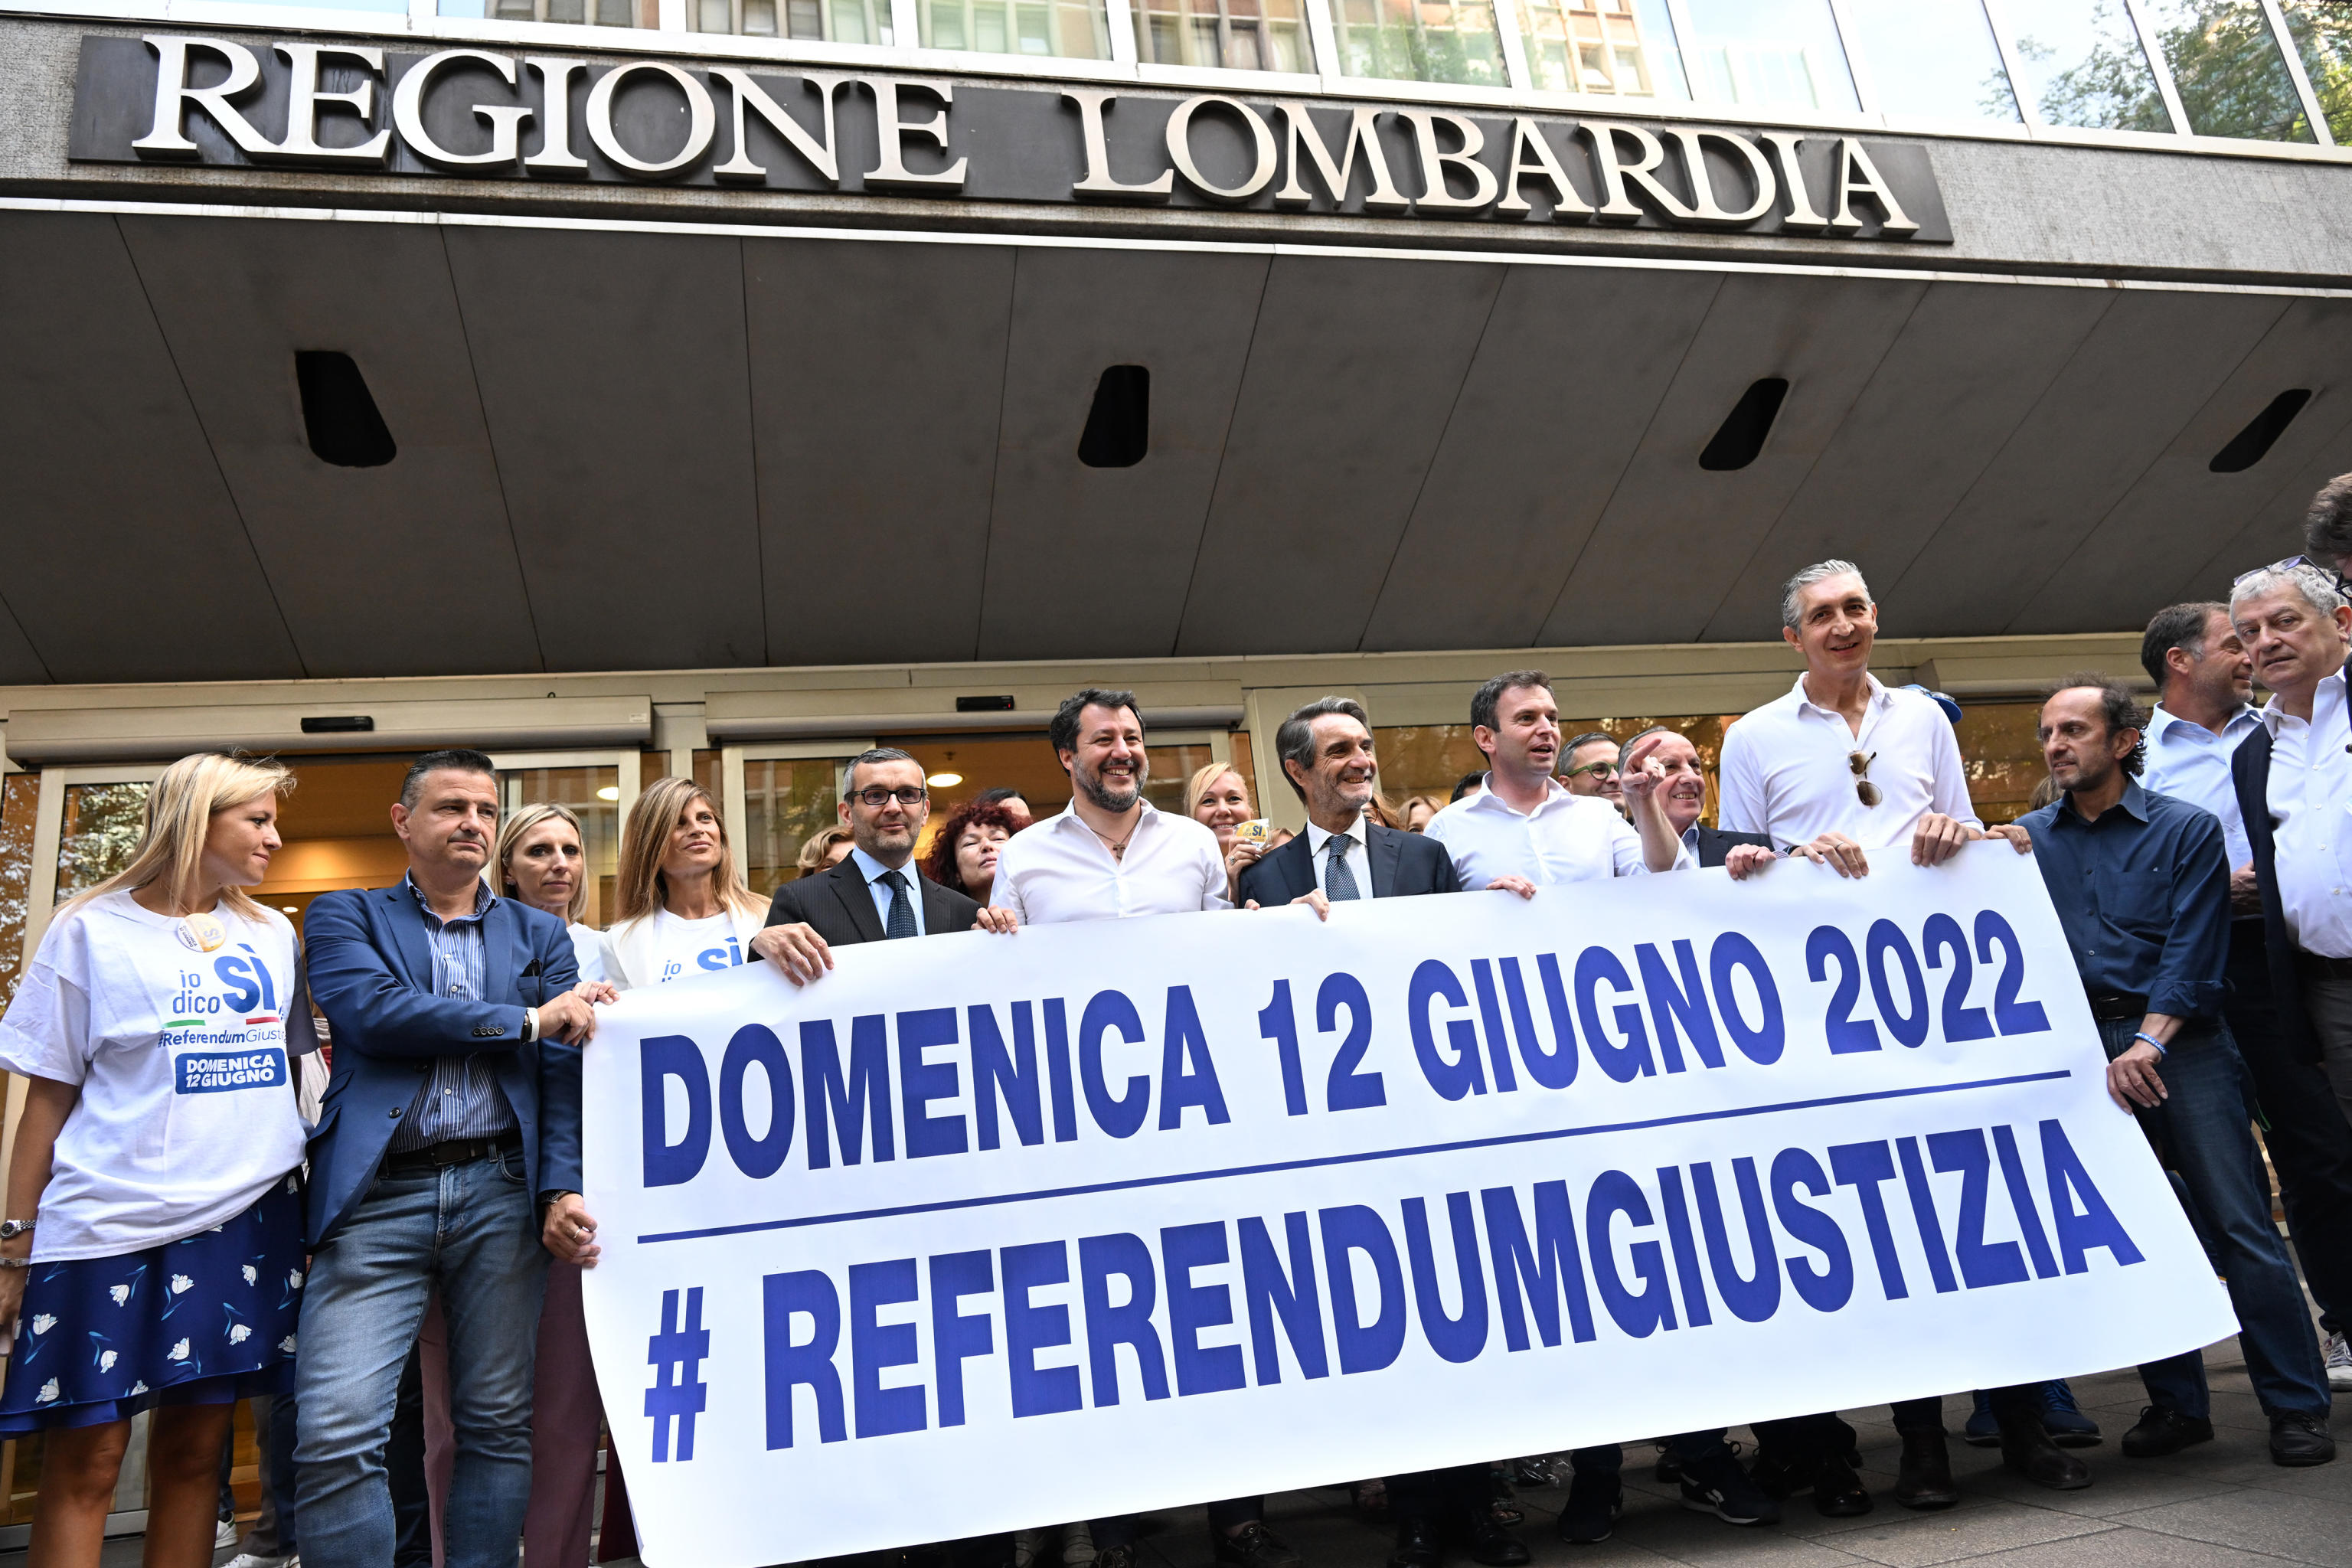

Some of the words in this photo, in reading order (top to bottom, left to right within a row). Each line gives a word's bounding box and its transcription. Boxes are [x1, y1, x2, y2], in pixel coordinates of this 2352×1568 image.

[132, 34, 968, 189] REGIONE
[1061, 89, 1920, 234] LOMBARDIA
[173, 990, 220, 1014] dico
[214, 943, 276, 1014] SÌ
[179, 969, 201, 988] io
[664, 959, 681, 975] io
[186, 1054, 276, 1073] DOMENICA
[641, 985, 1231, 1187] DOMENICA
[1259, 972, 1387, 1116] 12
[1409, 932, 1785, 1101] GIUGNO
[1806, 910, 2052, 1054] 2022
[186, 1073, 201, 1088] 12
[201, 1068, 275, 1087] GIUGNO
[763, 1119, 2145, 1451] REFERENDUMGIUSTIZIA
